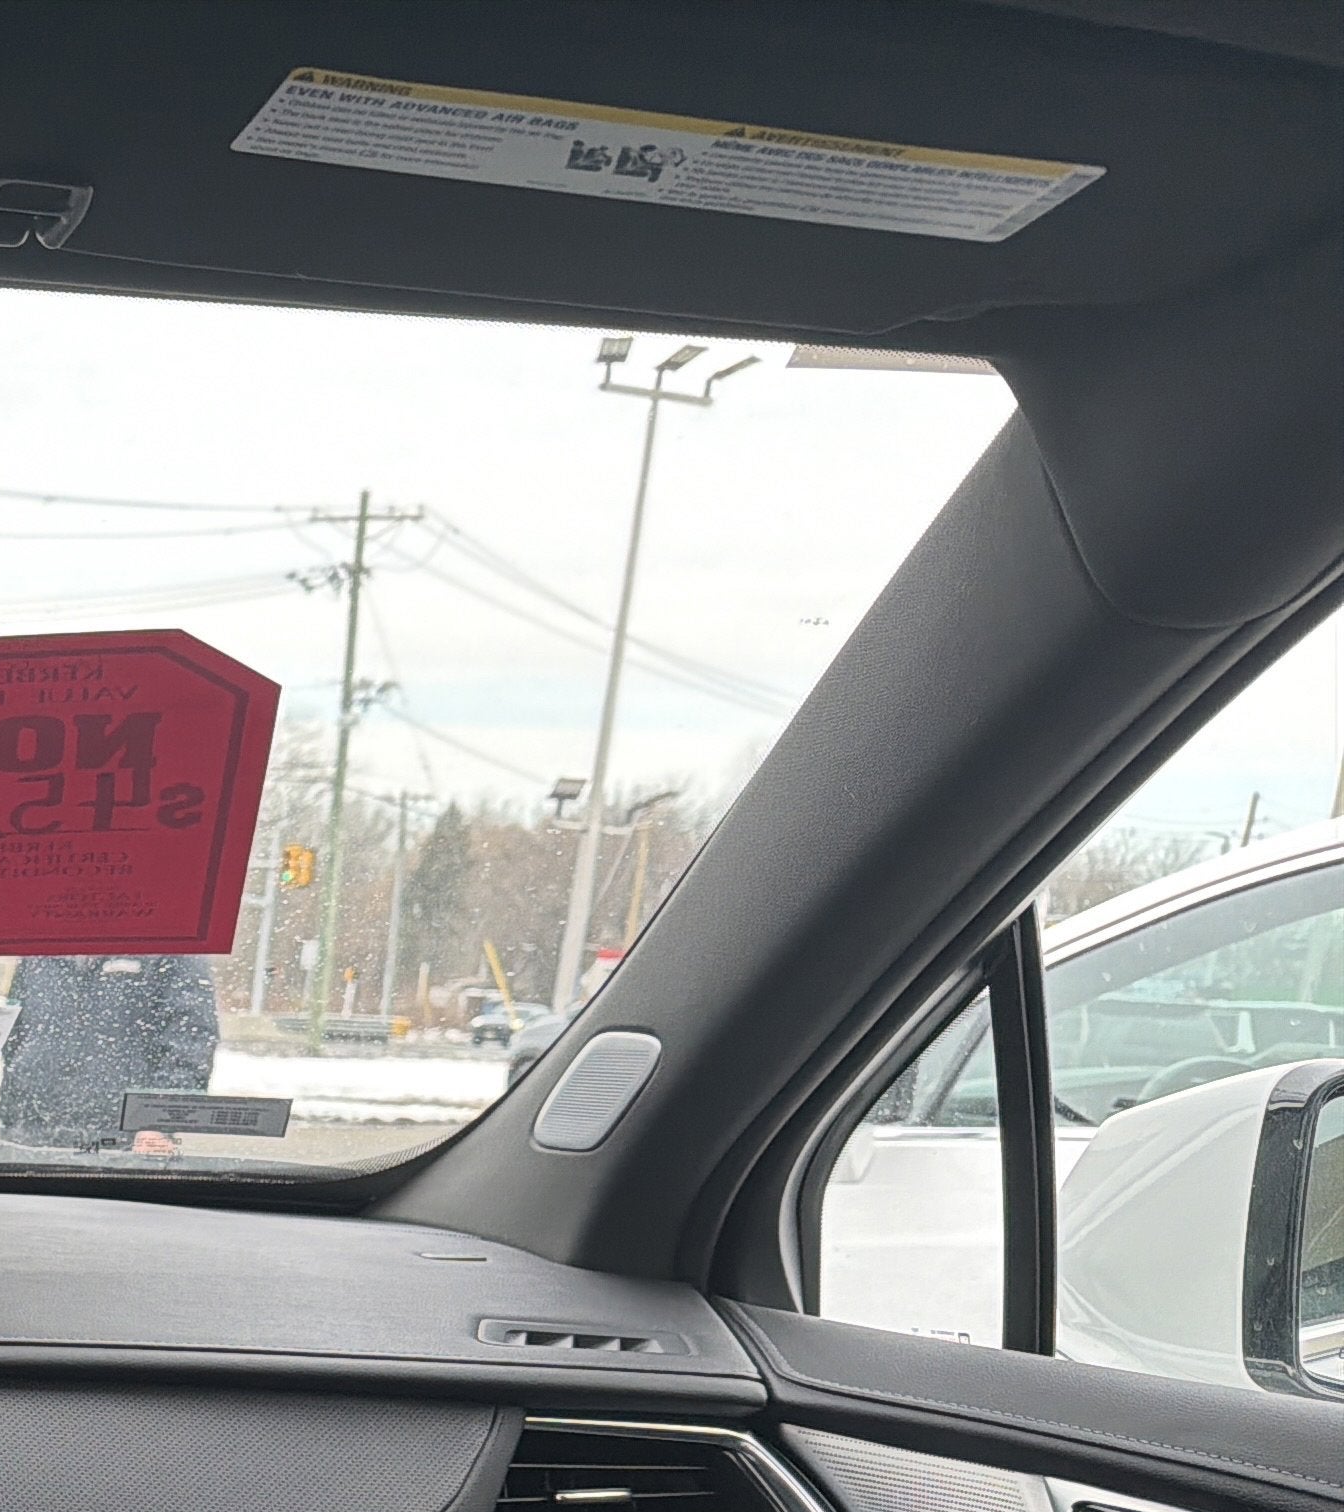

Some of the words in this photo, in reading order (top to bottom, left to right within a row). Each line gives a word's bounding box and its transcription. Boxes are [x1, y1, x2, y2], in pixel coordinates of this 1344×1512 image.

[285, 85, 334, 100] EVEN
[339, 92, 386, 108] WITH
[390, 101, 488, 120] ADVANCED
[491, 112, 526, 124] AIR
[527, 116, 580, 131] BAGS
